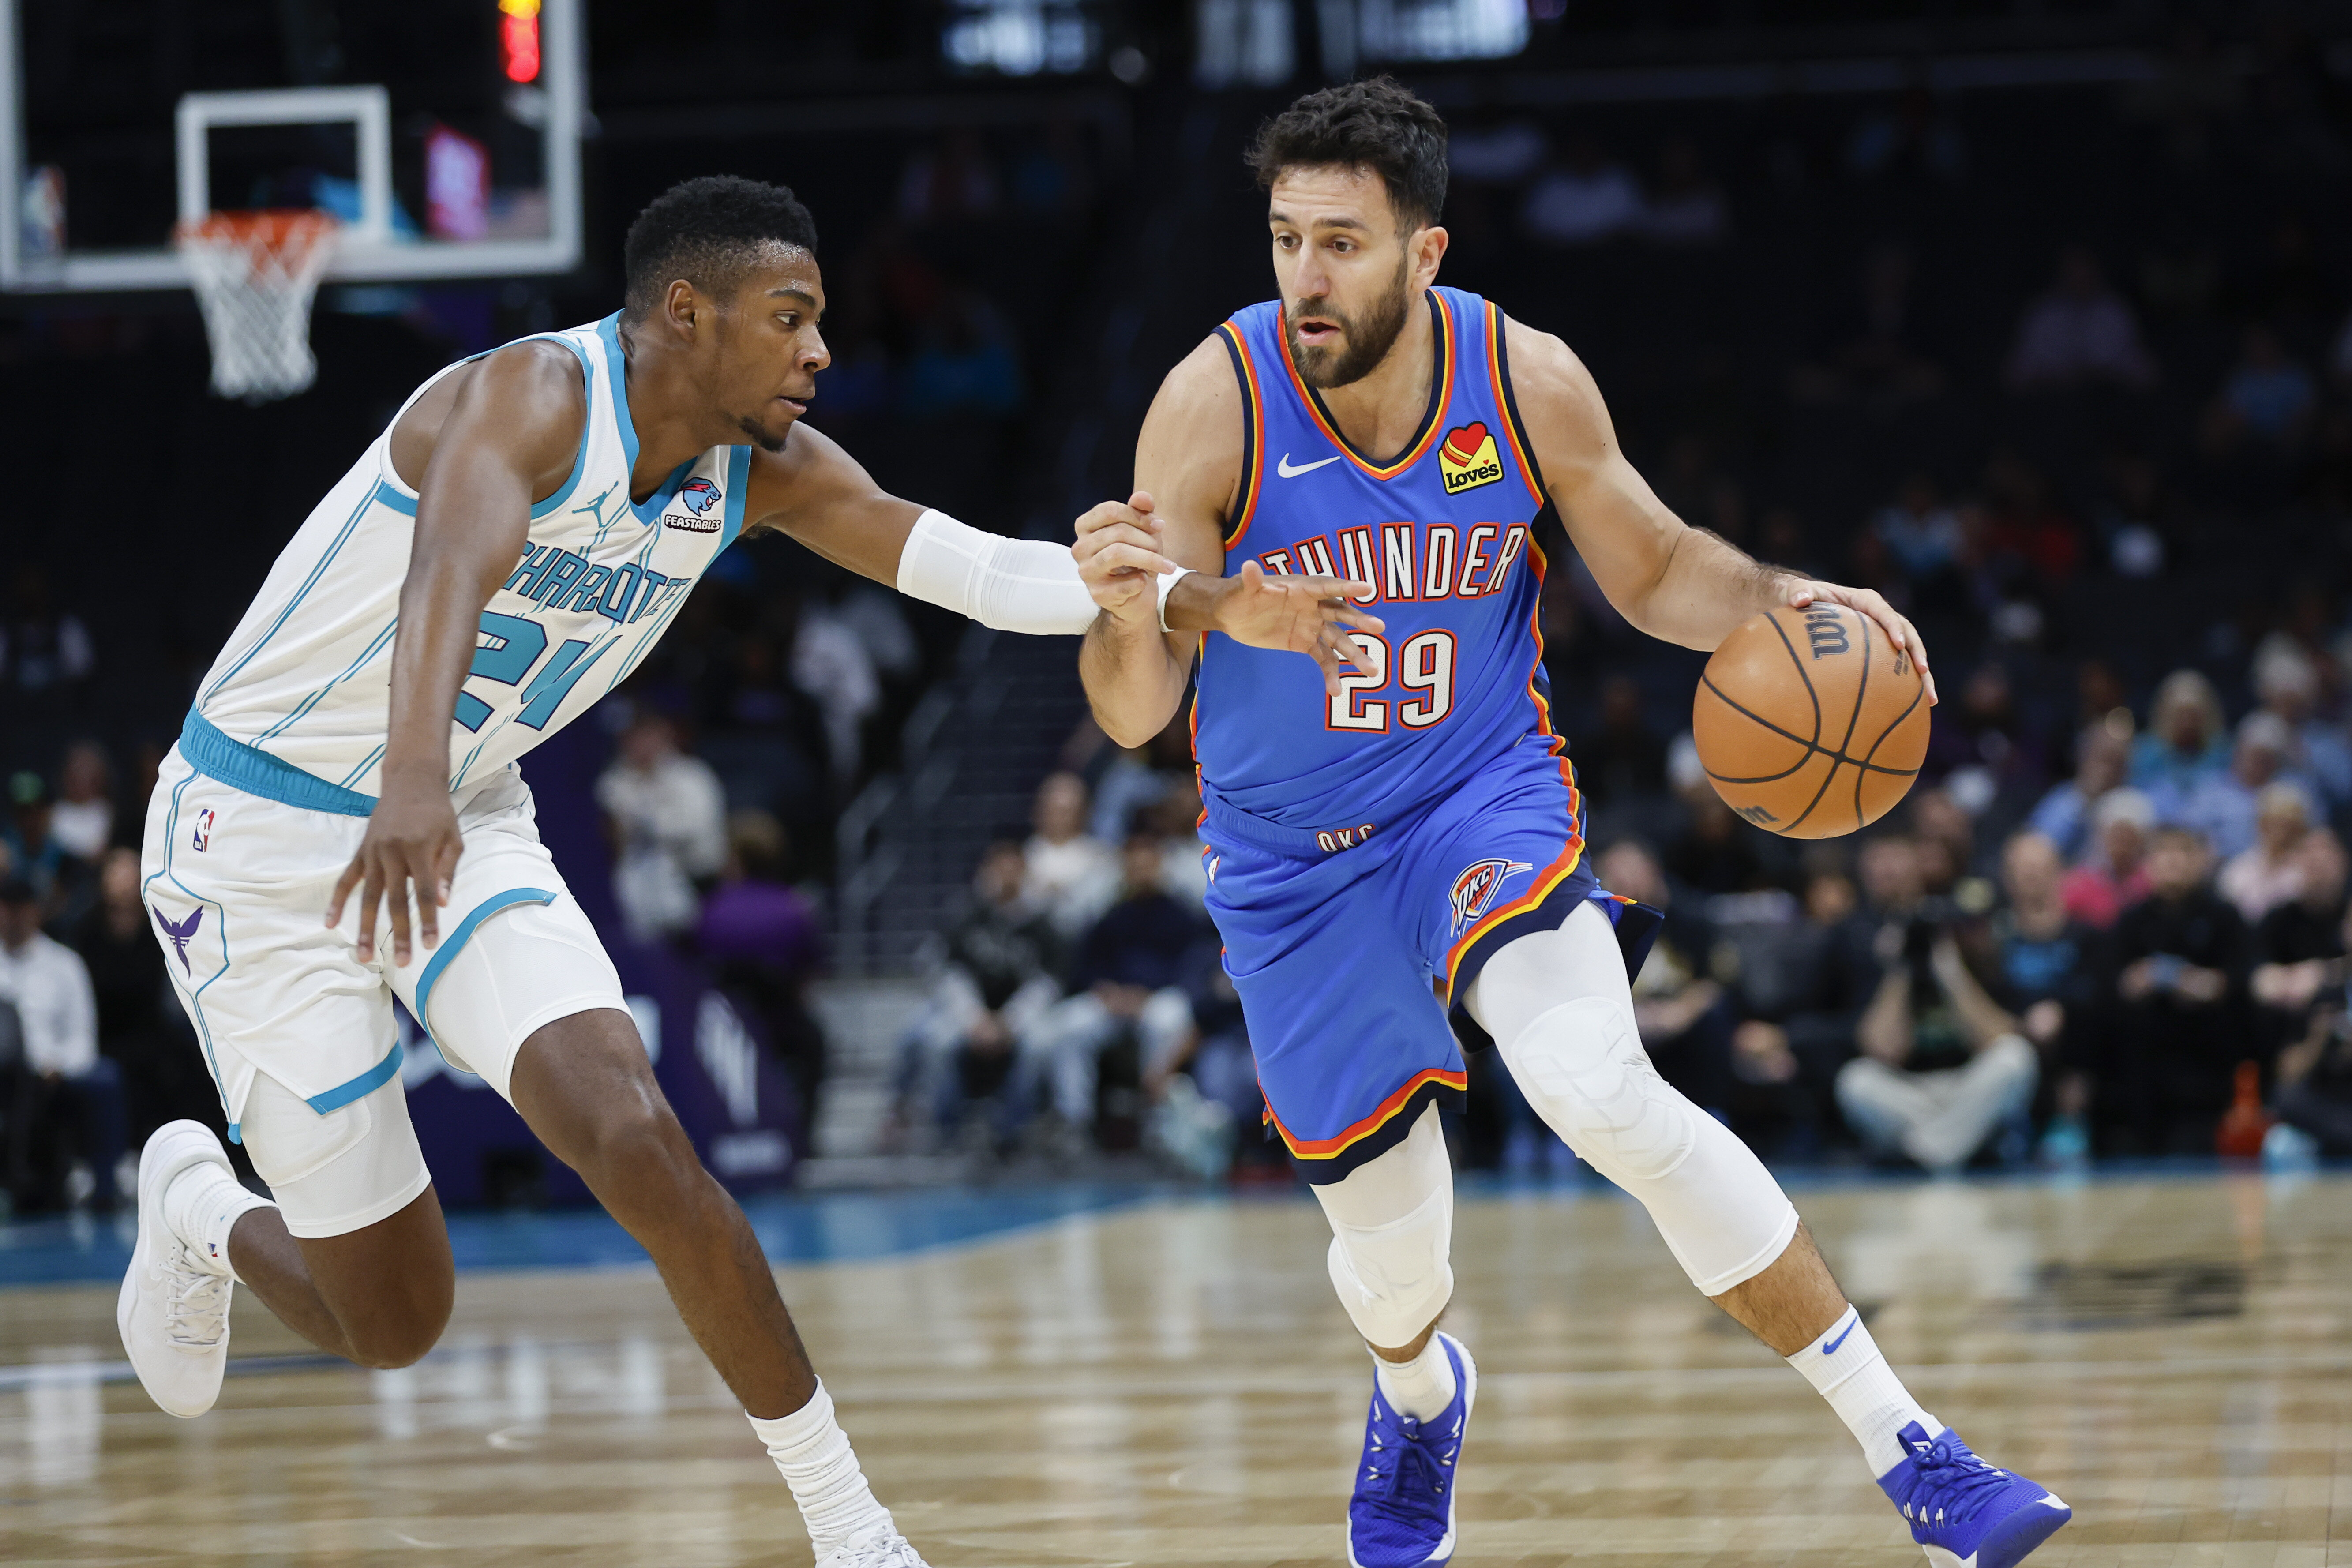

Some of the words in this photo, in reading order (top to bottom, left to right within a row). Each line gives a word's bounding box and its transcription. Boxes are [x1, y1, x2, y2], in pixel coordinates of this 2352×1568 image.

[665, 515, 721, 532] FEASTABLES
[502, 541, 692, 623] HAROTTE
[1325, 628, 1457, 734] 29
[1316, 823, 1376, 852] OKC
[1456, 867, 1492, 927] OKC
